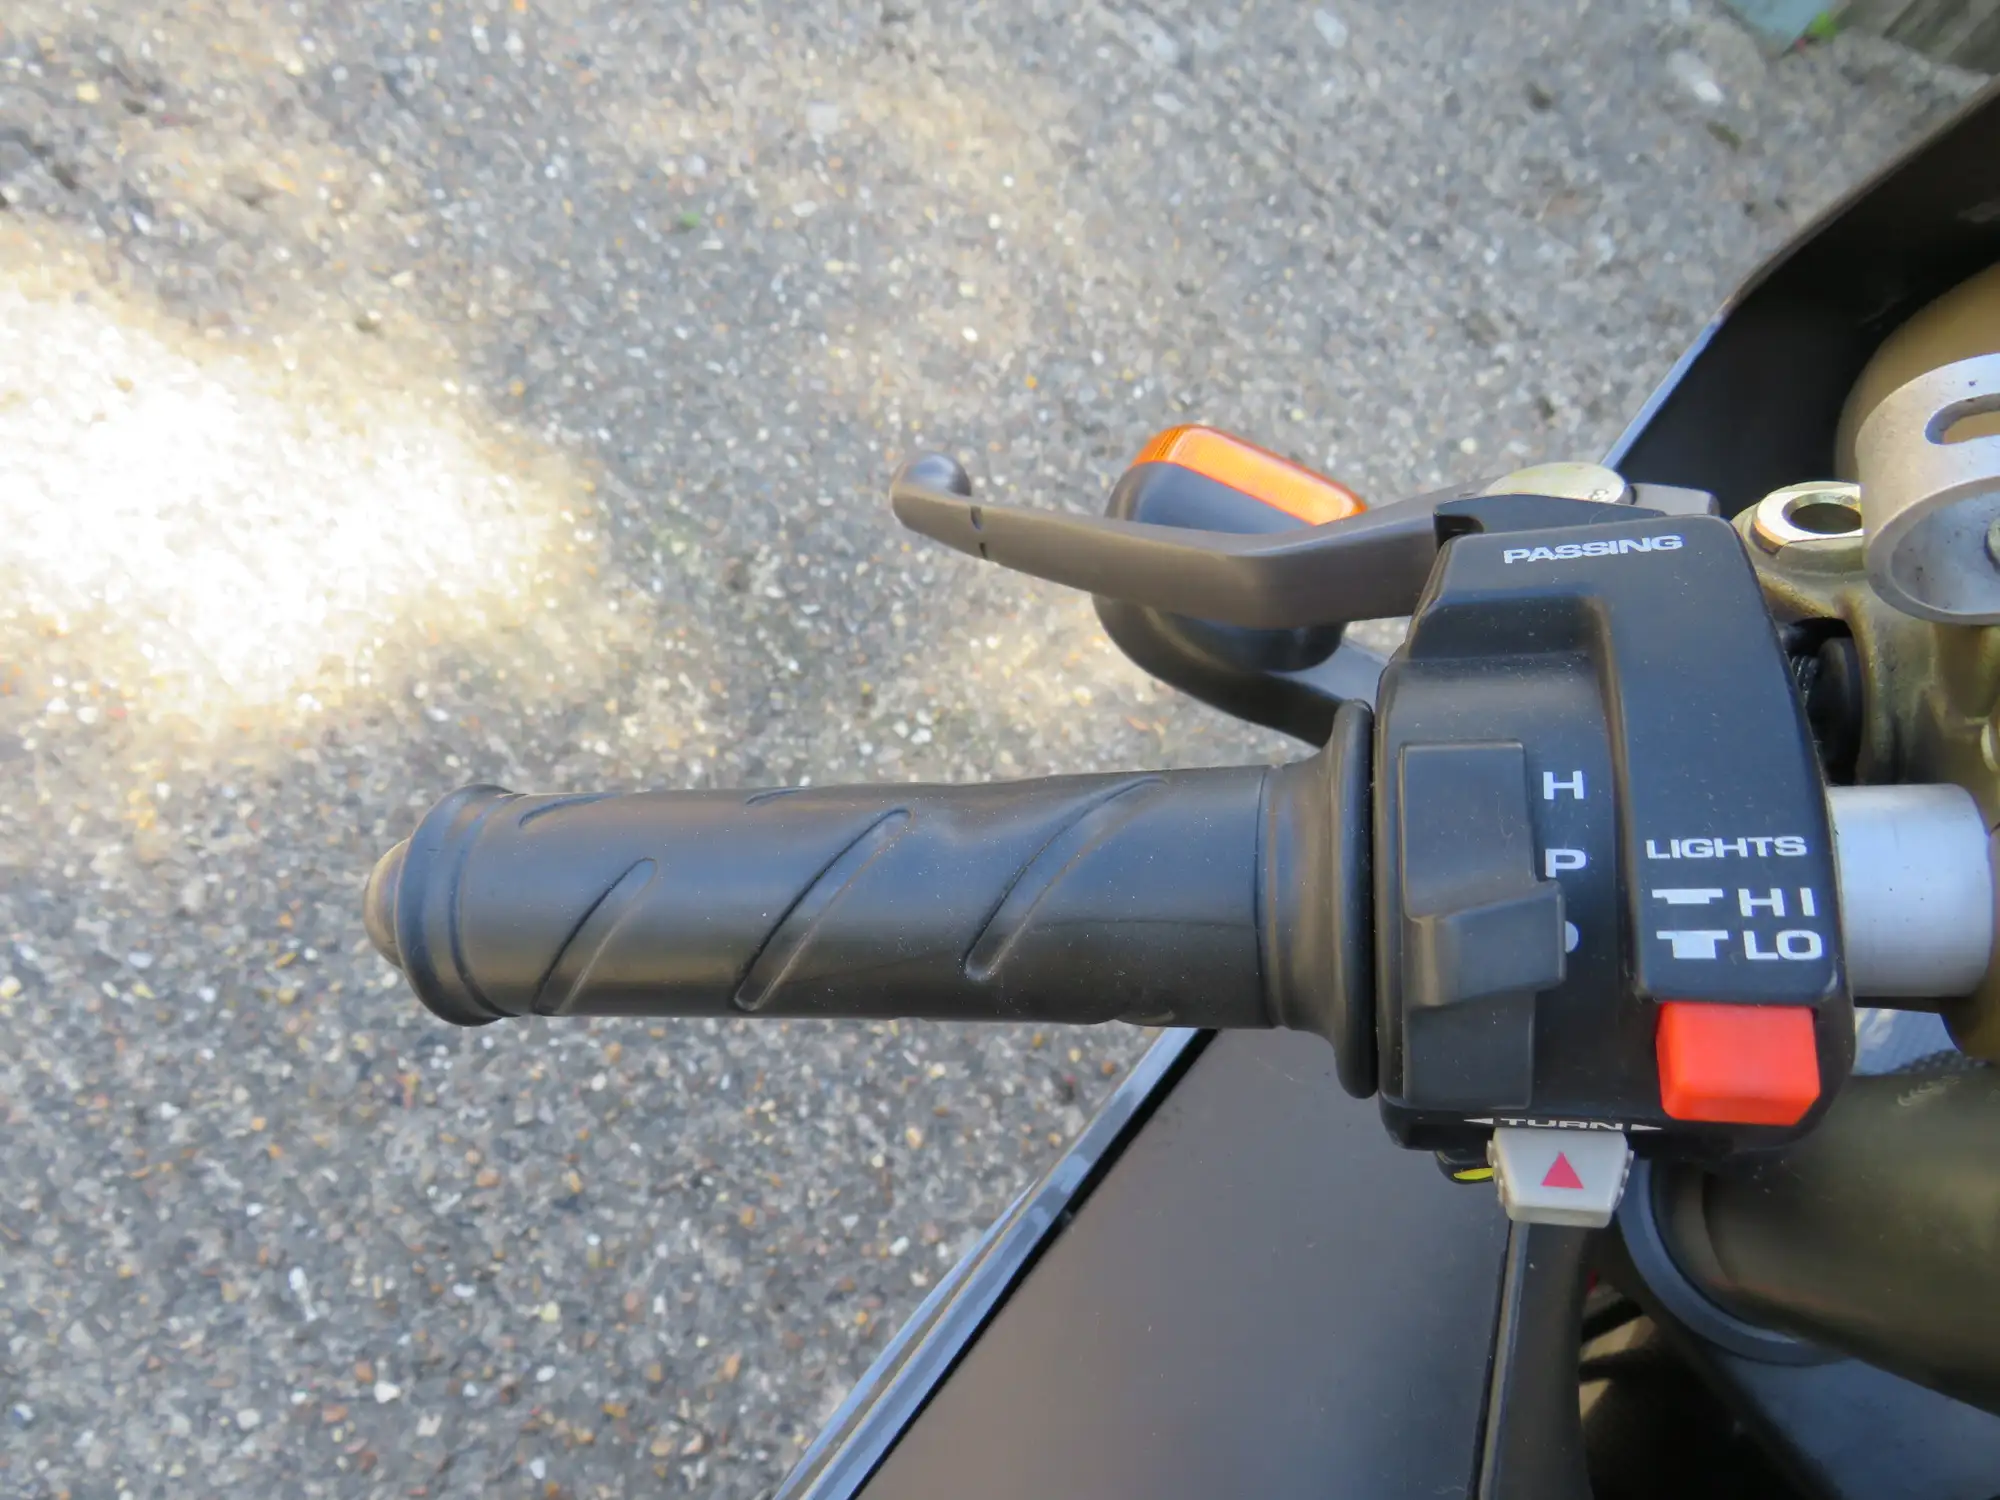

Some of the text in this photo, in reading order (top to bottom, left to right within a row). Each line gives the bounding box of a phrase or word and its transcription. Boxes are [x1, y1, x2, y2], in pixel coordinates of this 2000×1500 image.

[1503, 535, 1684, 564] PASSING
[1543, 770, 1585, 800] H
[1646, 835, 1808, 860] LIGHTS
[1545, 848, 1587, 878] P
[1743, 929, 1823, 961] LO
[1500, 1117, 1624, 1131] TURN
